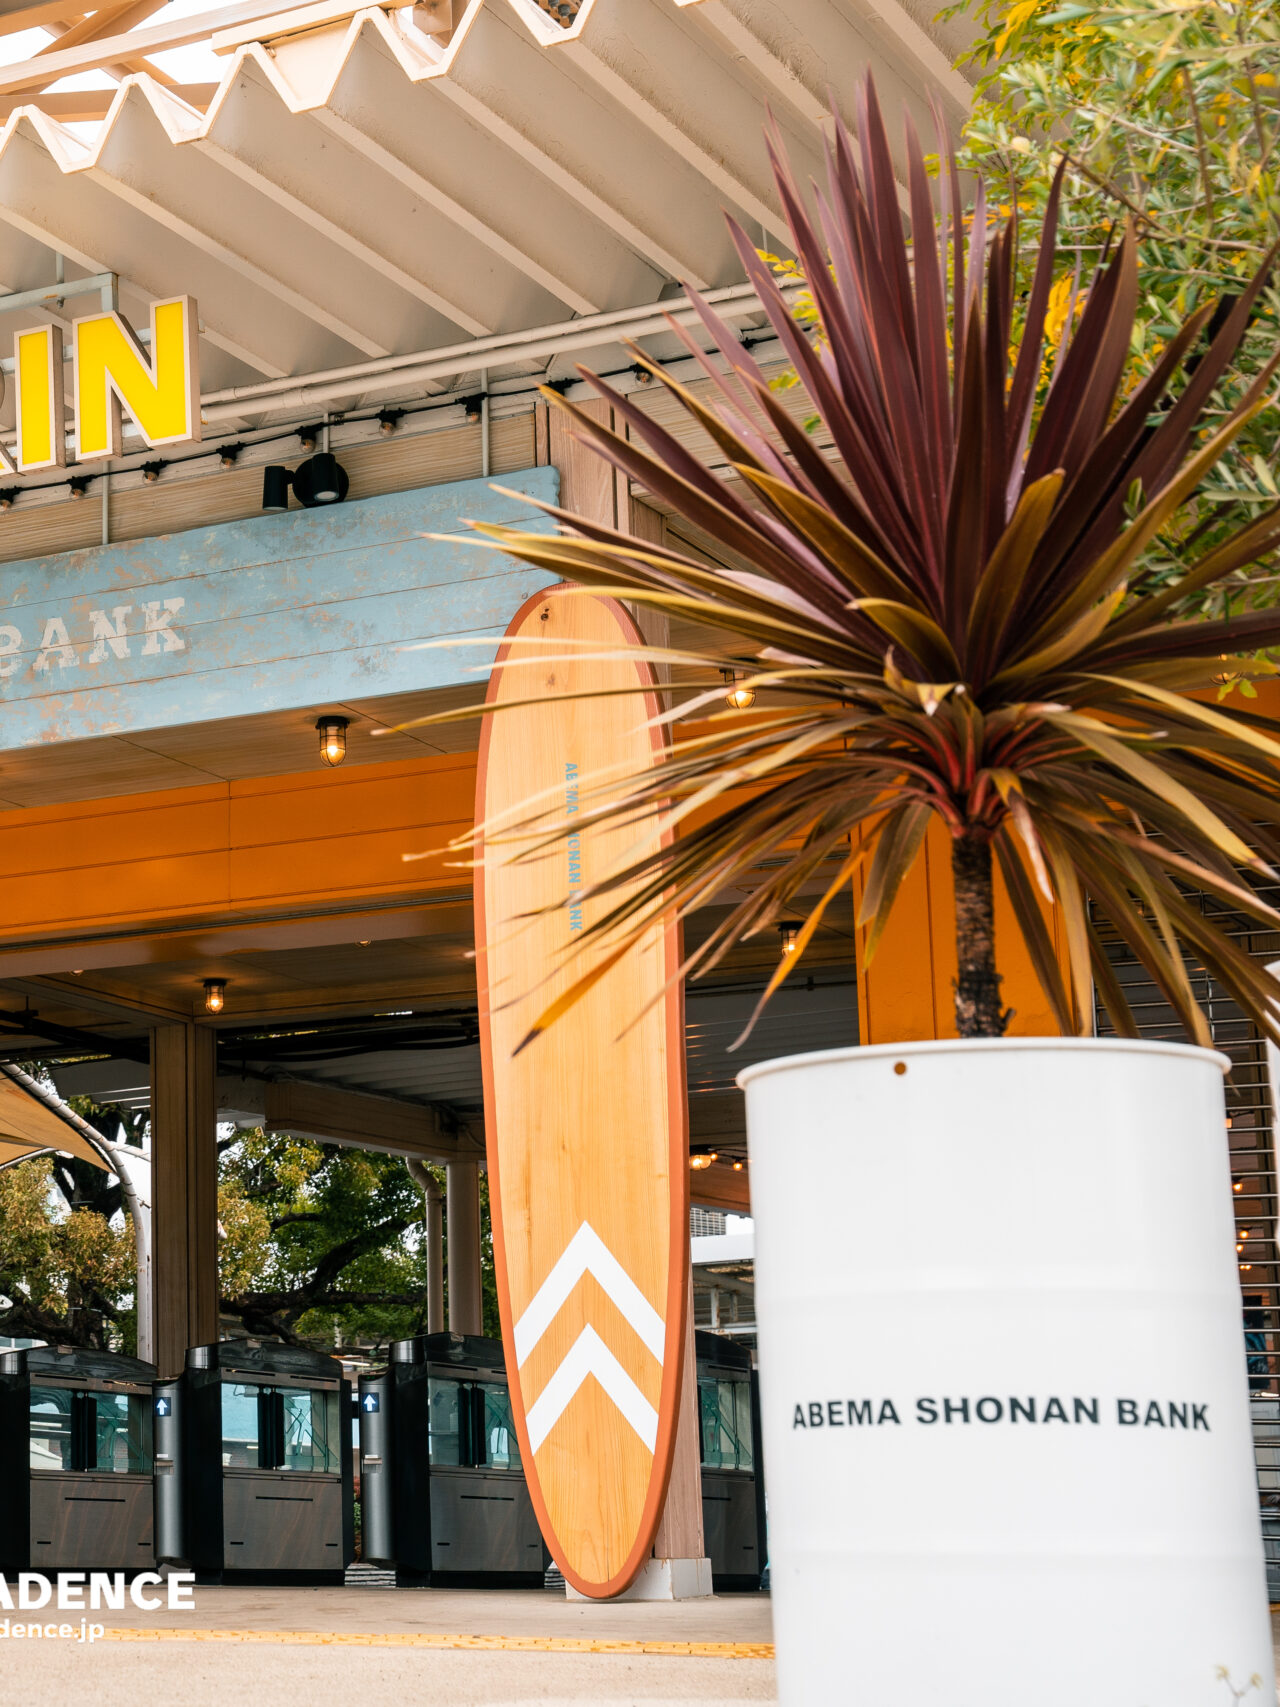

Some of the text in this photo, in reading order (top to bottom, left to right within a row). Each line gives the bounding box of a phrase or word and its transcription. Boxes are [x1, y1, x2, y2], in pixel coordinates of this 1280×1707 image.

[792, 1396, 1212, 1432] ABEMA SHONAN BANK
